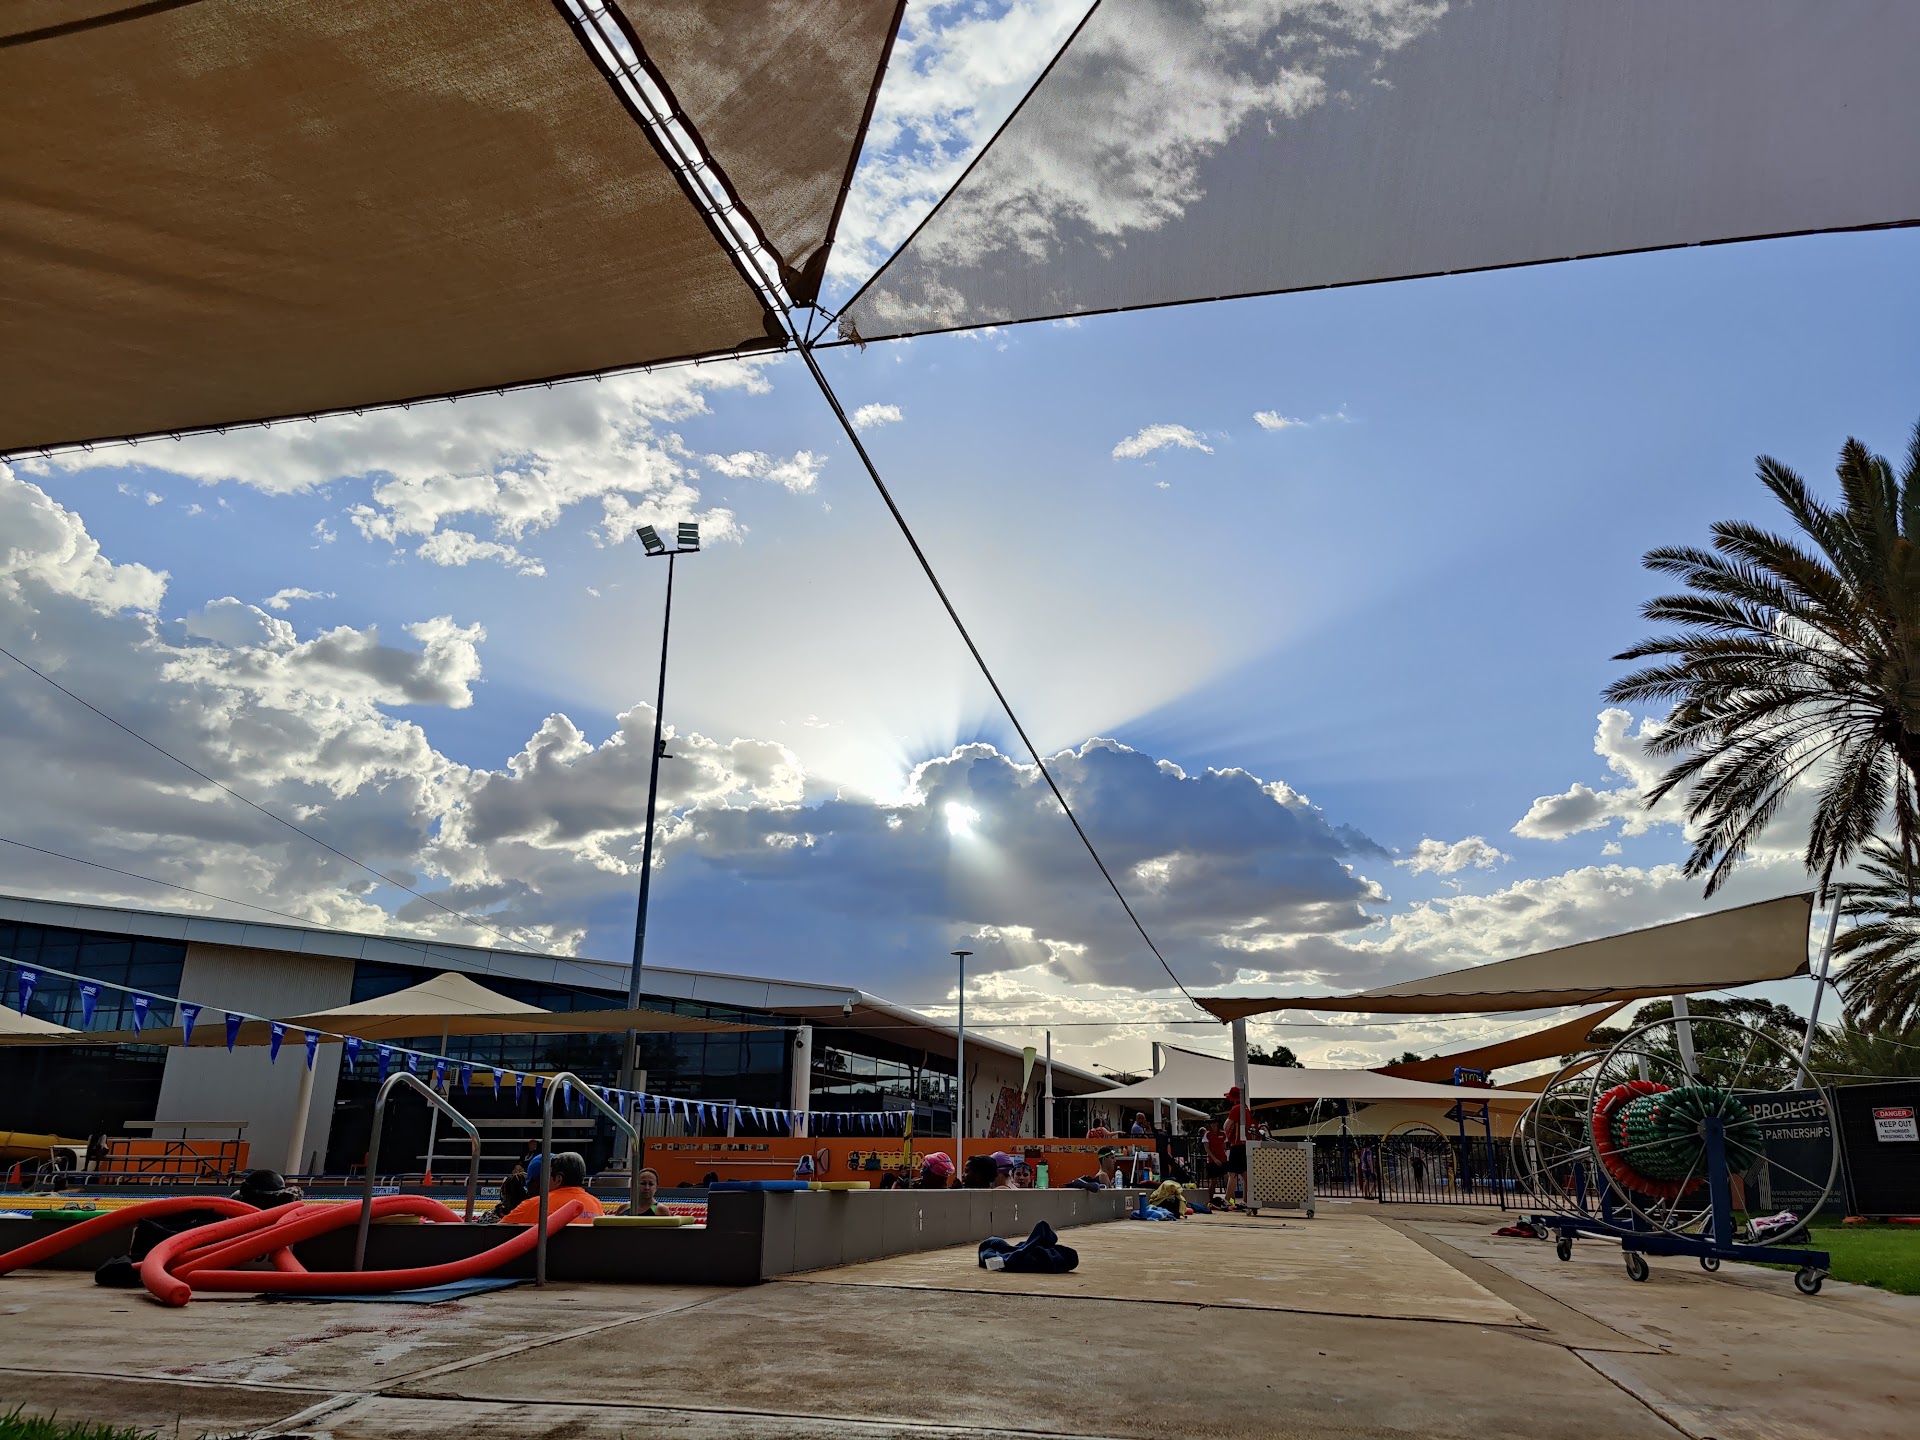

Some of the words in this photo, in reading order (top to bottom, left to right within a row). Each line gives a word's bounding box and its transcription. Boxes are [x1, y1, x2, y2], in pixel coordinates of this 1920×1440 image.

[1753, 1099, 1827, 1119] PROJECTS
[1879, 1120, 1896, 1128] KEEP
[1898, 1120, 1912, 1128] OUT
[1766, 1126, 1831, 1140] PARTNERSHIPS
